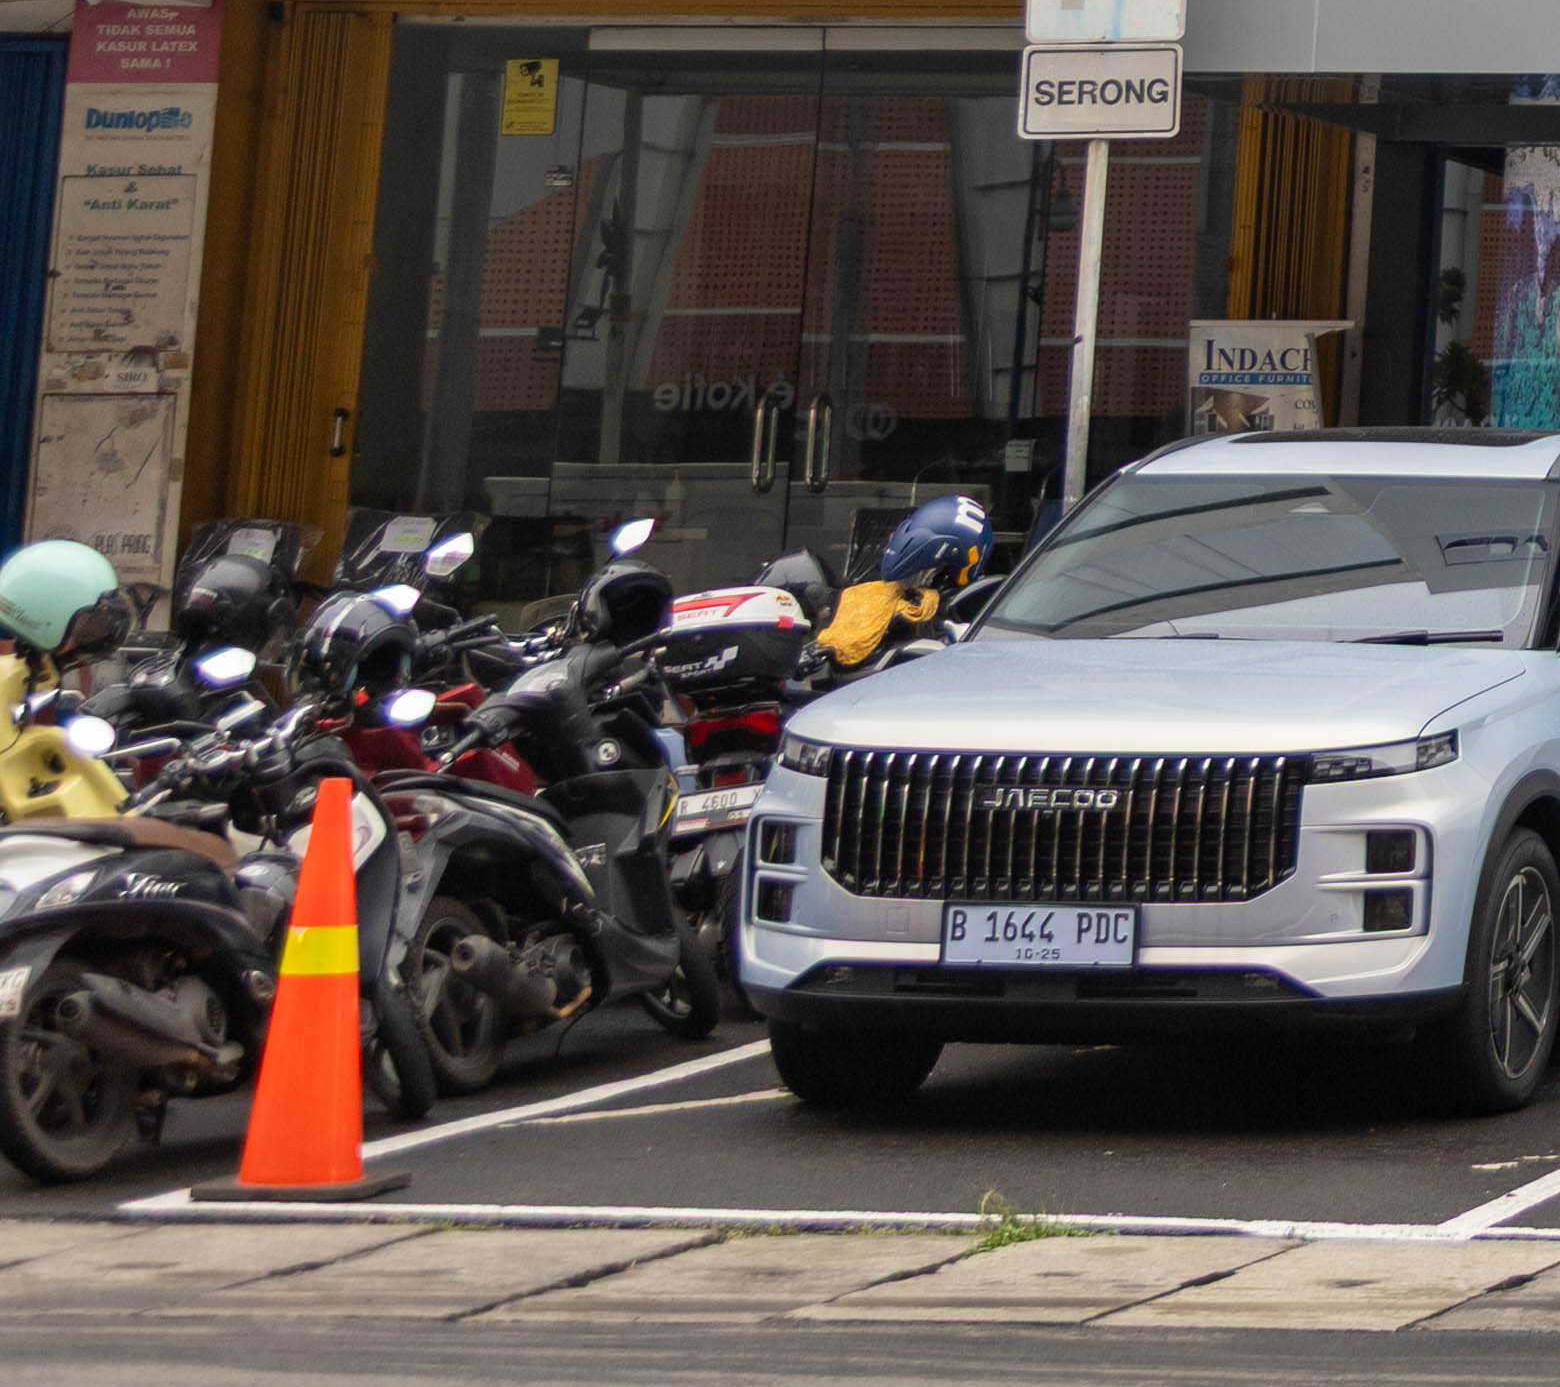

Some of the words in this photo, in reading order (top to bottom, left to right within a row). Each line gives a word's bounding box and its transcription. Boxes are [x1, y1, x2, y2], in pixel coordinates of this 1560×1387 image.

[96, 24, 141, 36] TIDAK
[146, 24, 196, 36] SEMUA
[96, 40, 147, 52] KASUR
[151, 40, 198, 52] LATEX
[120, 58, 161, 69] SAMA
[1033, 75, 1170, 108] SERONG
[1201, 374, 1251, 384] OFFICE
[663, 661, 704, 674] SEAT
[983, 786, 1120, 811] JAECOO
[950, 909, 967, 941] B
[984, 910, 1056, 943] 1644
[1076, 912, 1129, 944] PDC
